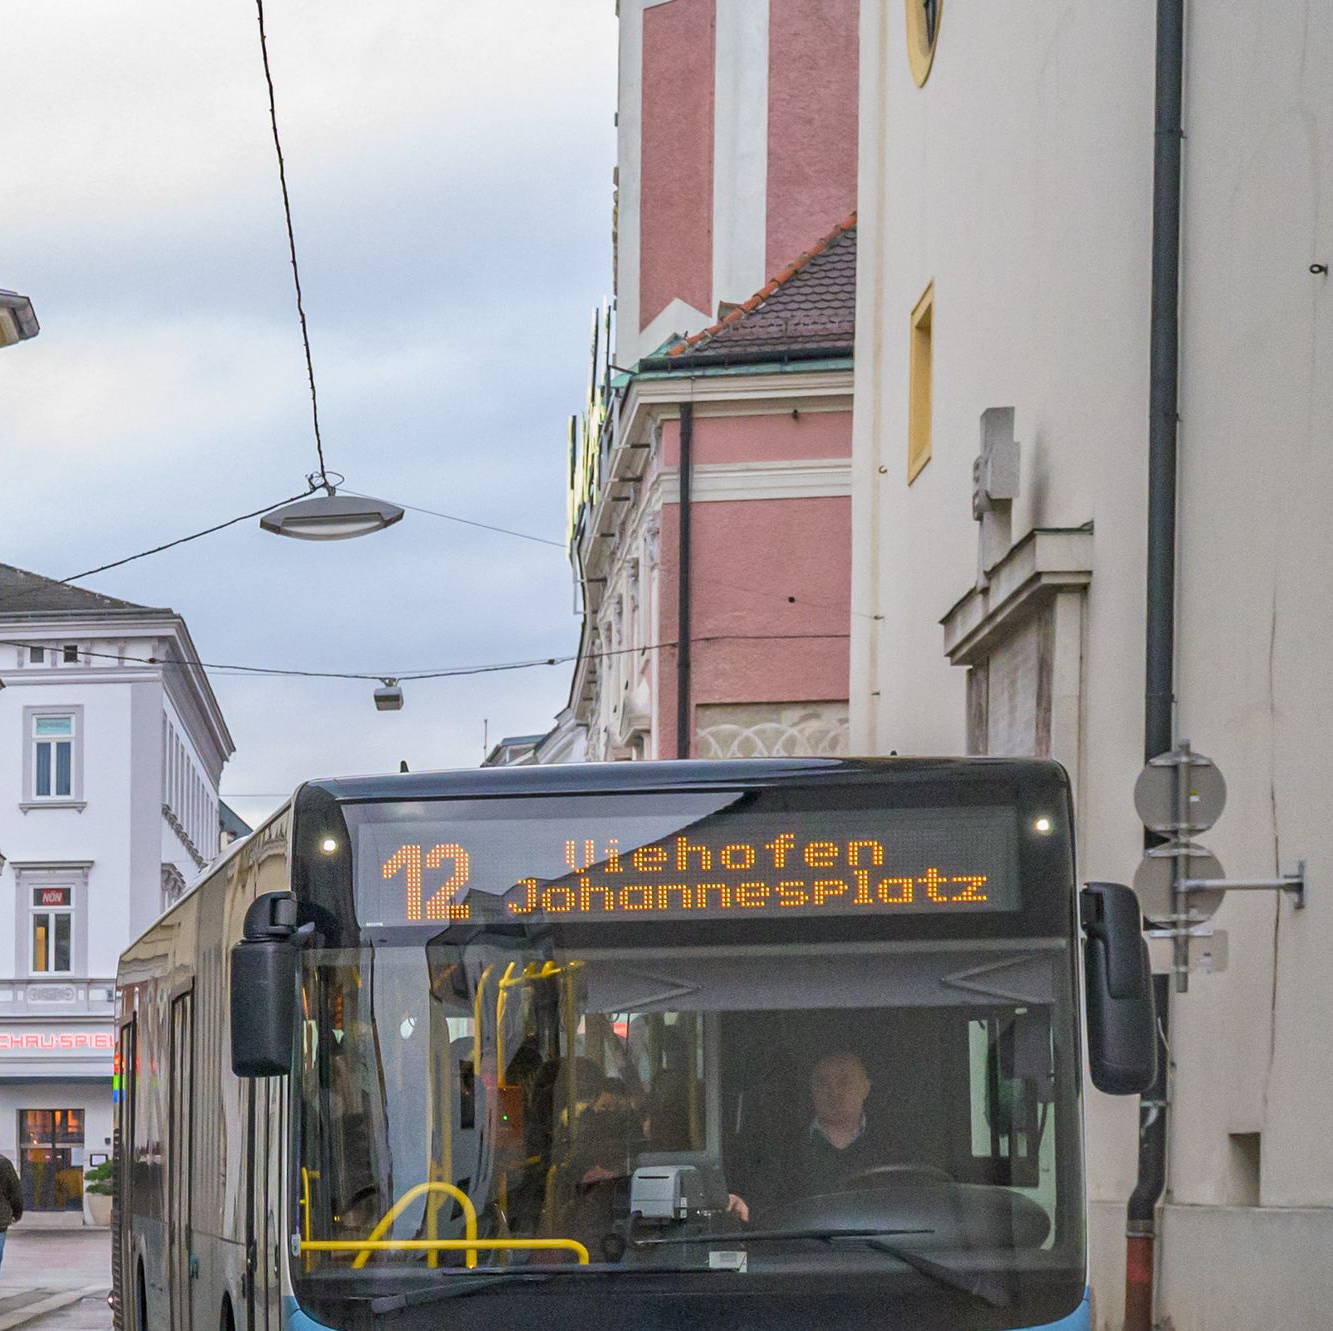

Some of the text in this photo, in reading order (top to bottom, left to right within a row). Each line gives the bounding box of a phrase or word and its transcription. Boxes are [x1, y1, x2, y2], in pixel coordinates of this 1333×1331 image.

[381, 833, 885, 921] 12 Viehofen
[506, 867, 989, 916] Johannesplatz
